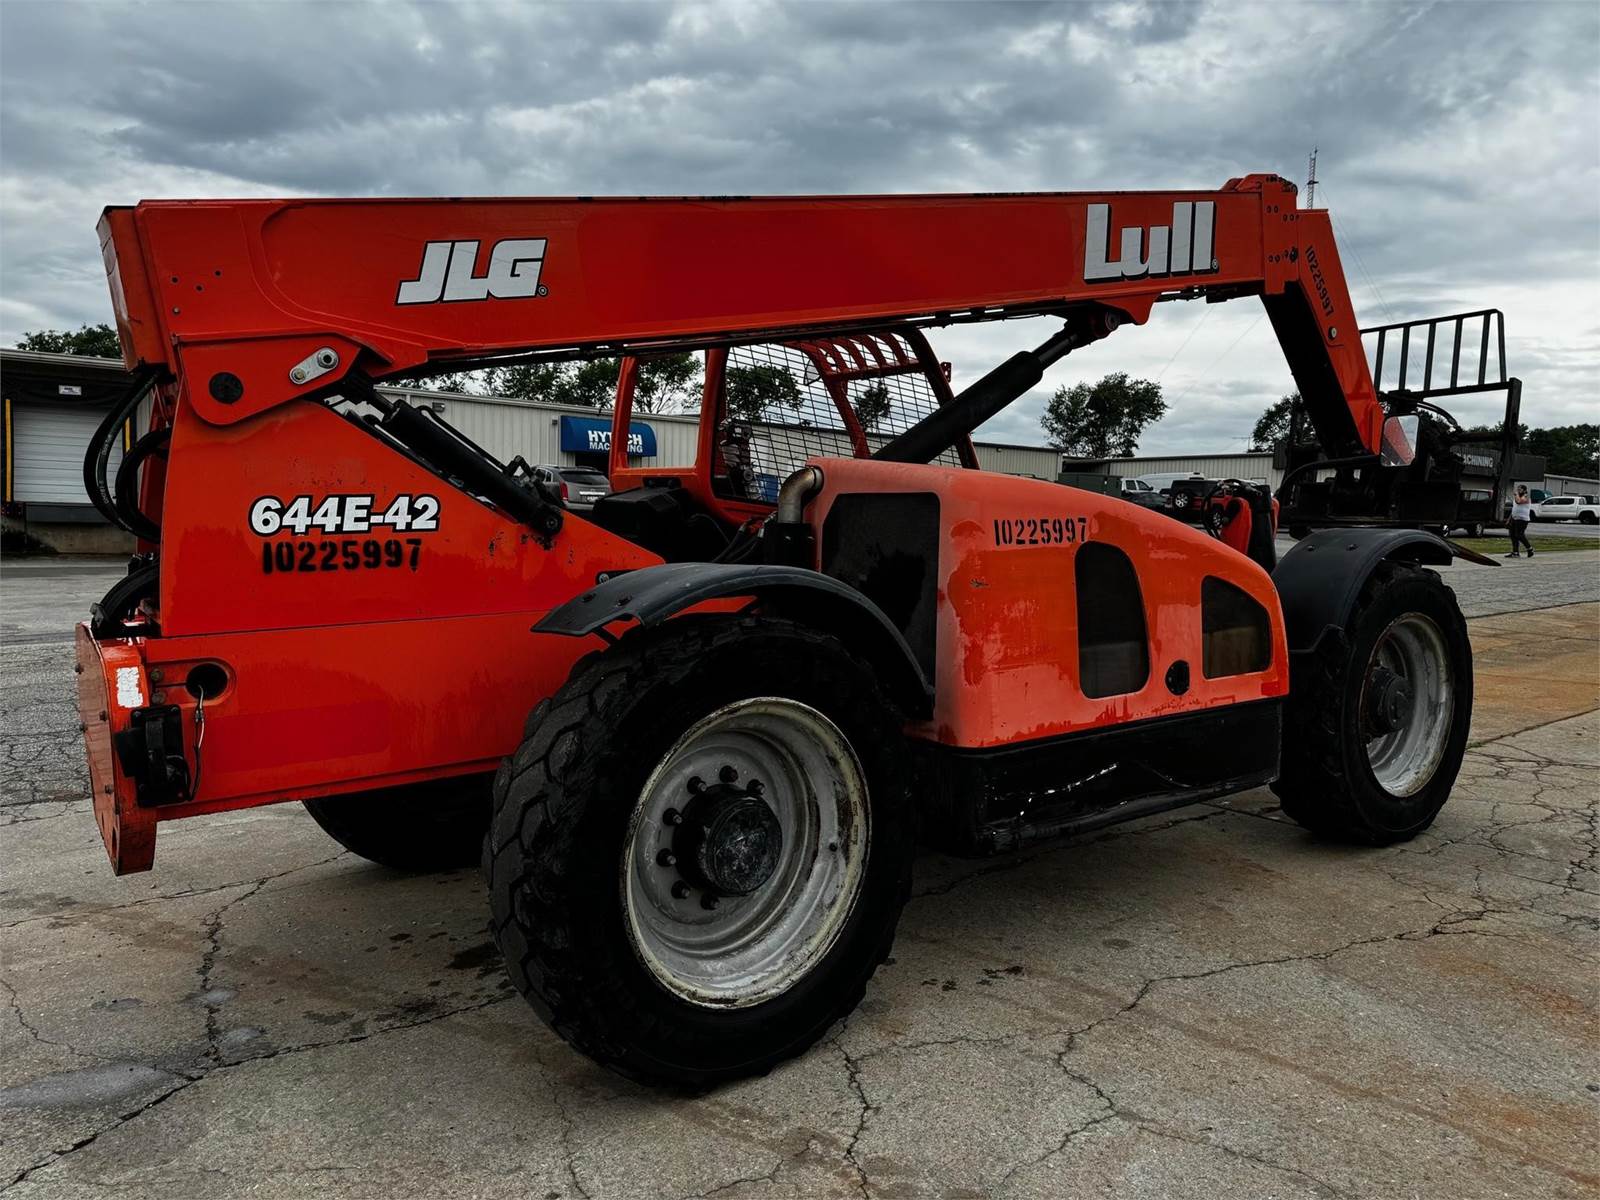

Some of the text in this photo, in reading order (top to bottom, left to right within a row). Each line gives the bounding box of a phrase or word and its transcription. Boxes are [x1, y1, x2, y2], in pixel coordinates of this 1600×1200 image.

[1083, 201, 1216, 284] Lull
[395, 238, 547, 305] JLG
[1305, 245, 1334, 317] 10225997
[587, 430, 643, 446] HYTCH
[589, 441, 643, 453] MACING
[249, 495, 441, 535] 644E-42
[994, 517, 1087, 546] 10225997
[263, 538, 422, 574] 10225997
